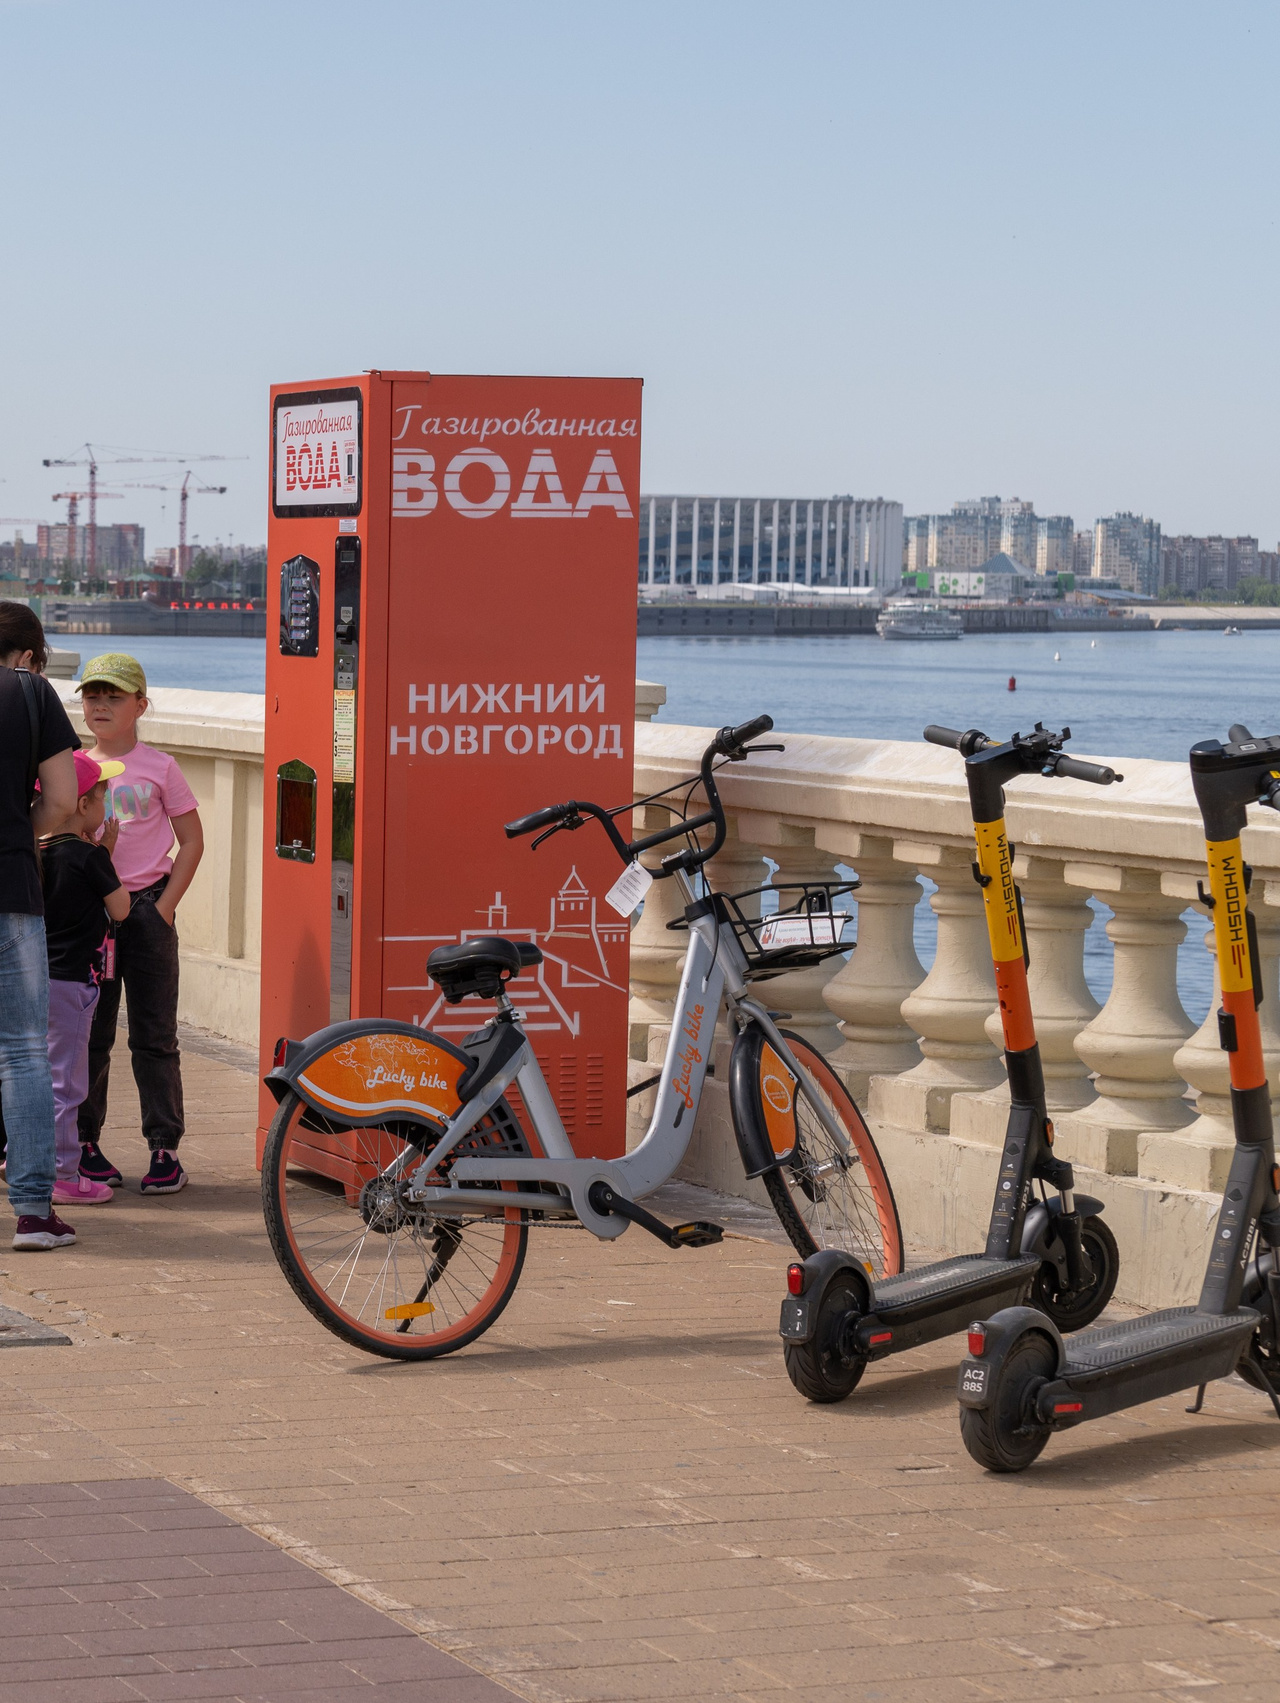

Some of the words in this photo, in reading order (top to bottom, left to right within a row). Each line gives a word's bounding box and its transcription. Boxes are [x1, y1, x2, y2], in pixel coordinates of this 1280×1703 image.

[282, 409, 352, 443] Газированная
[393, 405, 638, 442] Газированная
[286, 441, 341, 491] ВОДА
[392, 447, 634, 519] ВОДА
[409, 675, 606, 714] НИЖНИЙ
[390, 724, 624, 759] НОВГОРОД
[997, 833, 1016, 913] WHOOSH
[1222, 856, 1244, 942] WHOOSH
[683, 1004, 705, 1041] bike
[366, 1065, 416, 1092] Lucky
[419, 1071, 448, 1090] bike
[672, 1044, 703, 1109] Lucky
[962, 1381, 983, 1393] 885
[964, 1369, 985, 1381] AC2
